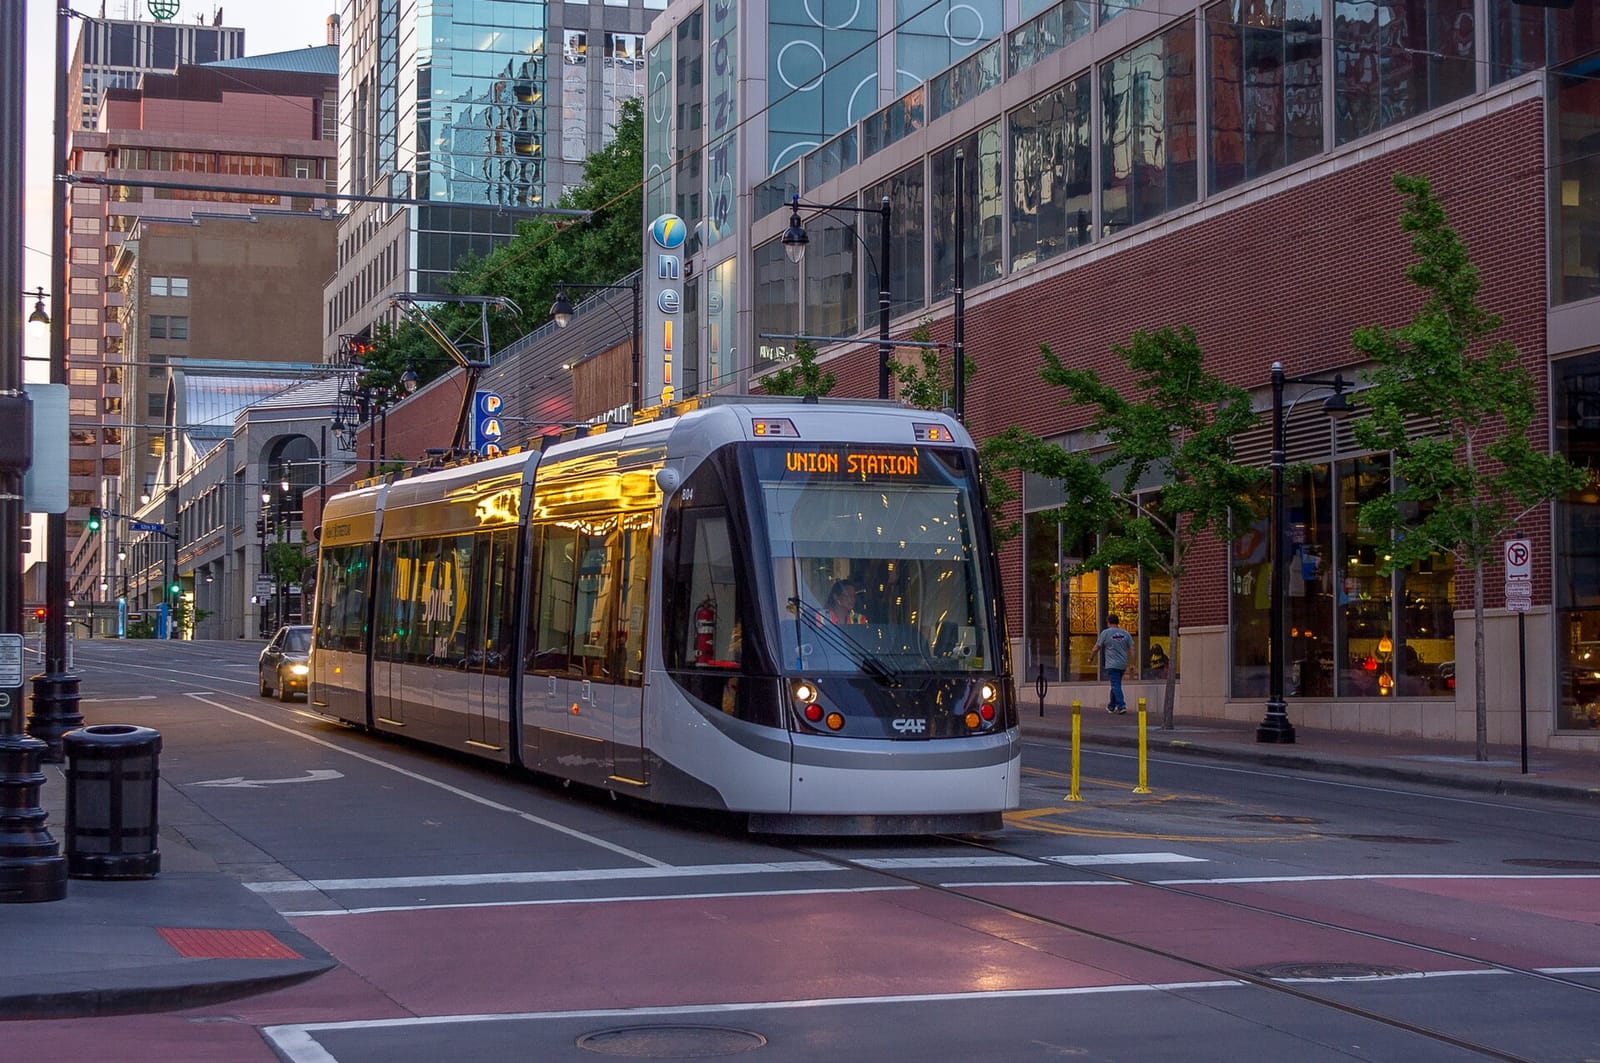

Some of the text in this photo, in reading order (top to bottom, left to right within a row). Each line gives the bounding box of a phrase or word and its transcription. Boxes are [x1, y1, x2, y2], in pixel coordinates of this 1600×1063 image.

[786, 452, 919, 475] UNION STATION
[892, 718, 927, 733] CAF
